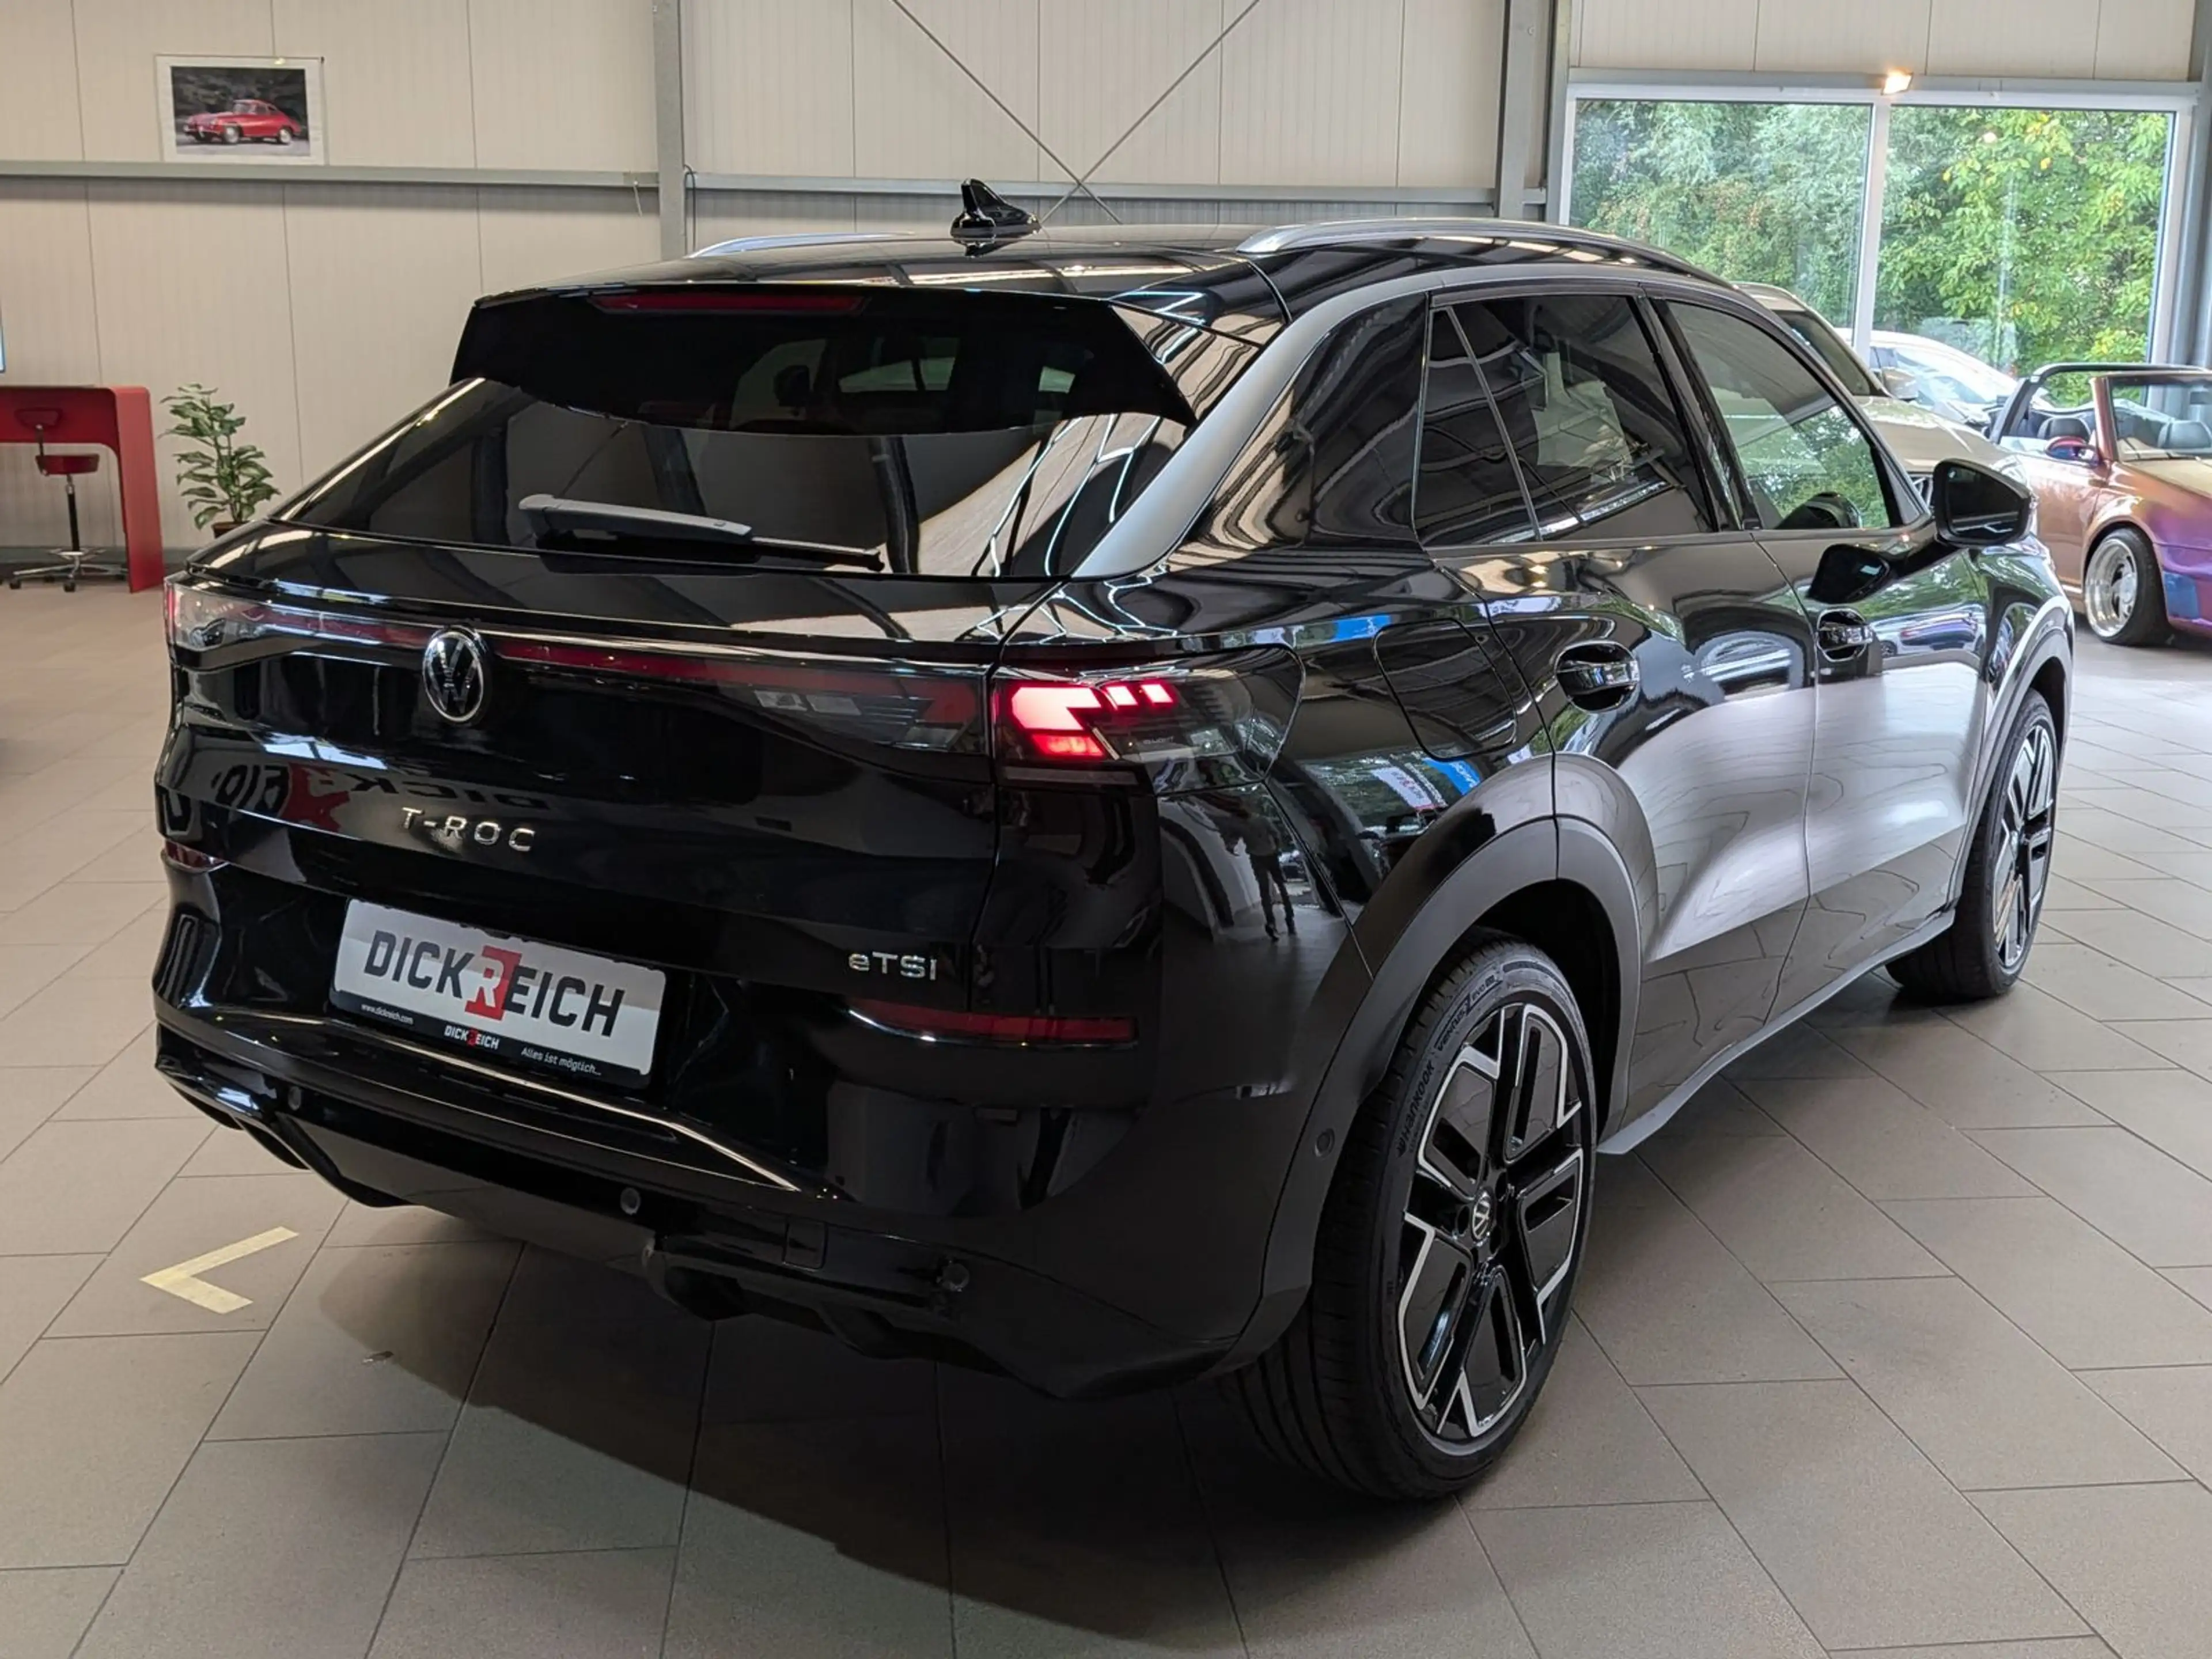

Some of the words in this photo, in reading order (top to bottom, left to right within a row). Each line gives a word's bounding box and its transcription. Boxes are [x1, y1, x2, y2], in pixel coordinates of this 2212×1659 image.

[402, 806, 536, 852] T-ROC
[363, 929, 626, 1038] DICKREICH
[521, 1047, 543, 1062] Alles
[544, 1052, 558, 1065] ist
